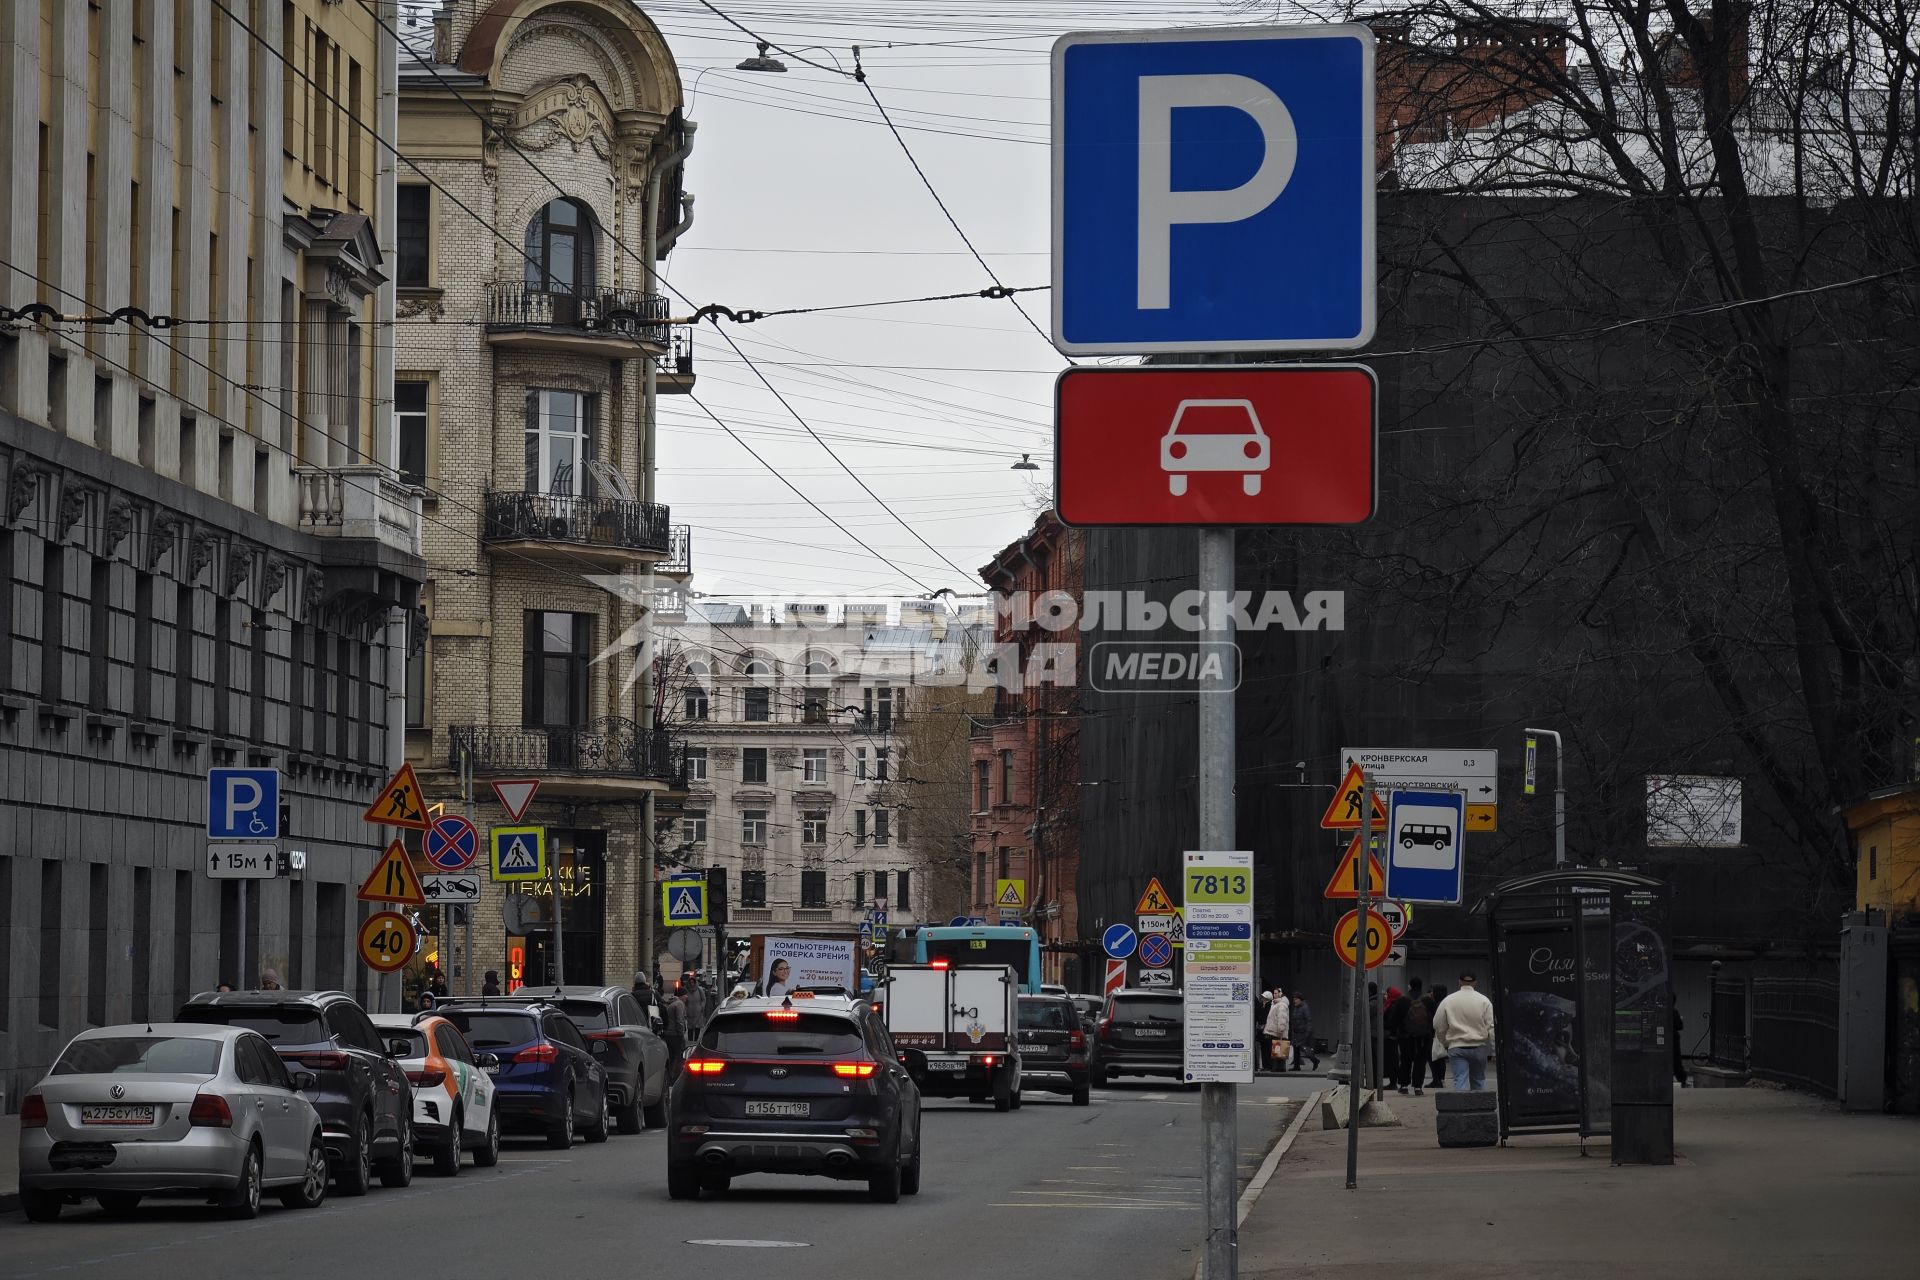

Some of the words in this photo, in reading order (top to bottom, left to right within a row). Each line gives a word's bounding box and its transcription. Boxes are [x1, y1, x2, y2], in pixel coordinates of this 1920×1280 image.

[1136, 73, 1298, 311] P
[1360, 754, 1428, 763] КРОНВЕРКСКАЯ
[1463, 759, 1475, 767] 0,3
[225, 777, 263, 830] P
[227, 853, 257, 868] 15м
[1190, 875, 1246, 895] 7813
[370, 930, 403, 954] 40
[1347, 925, 1379, 951] 40
[774, 941, 846, 952] КОМПЬЮТЕРНАЯ
[769, 950, 814, 959] ПРОВЕРКА
[816, 952, 850, 961] ЗРЕНИЯ
[806, 973, 816, 981] 20
[817, 974, 844, 983] минут
[86, 1107, 131, 1119] А275СУ
[133, 1106, 150, 1115] 178
[748, 1102, 790, 1113] В156ТТ
[791, 1103, 808, 1112] 198
